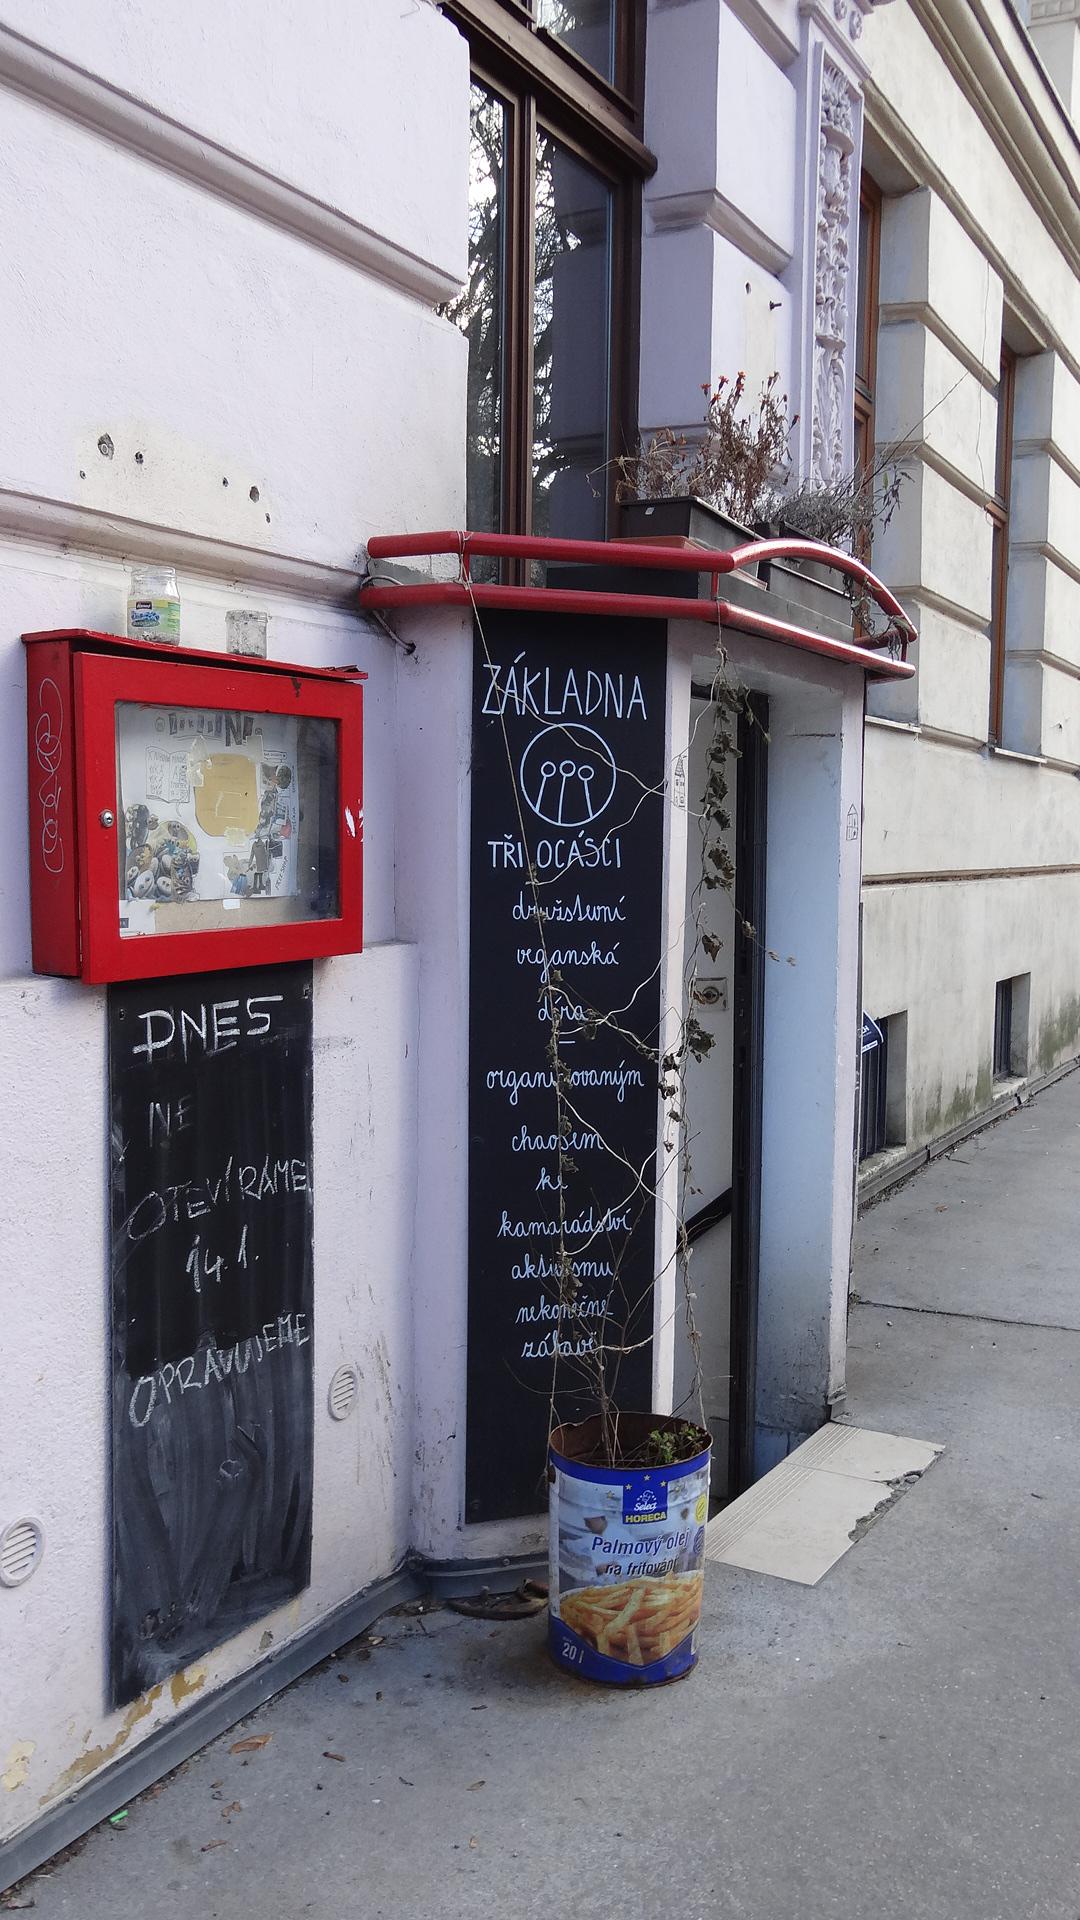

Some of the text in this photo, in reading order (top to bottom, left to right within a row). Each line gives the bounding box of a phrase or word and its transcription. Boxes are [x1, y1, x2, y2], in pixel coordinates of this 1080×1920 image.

[482, 651, 647, 720] ZÁKLADNA
[487, 834, 523, 868] TŘI
[512, 891, 626, 922] družstevní
[516, 941, 619, 983] veganská
[538, 995, 589, 1021] dra
[132, 994, 284, 1064] DNES
[486, 1060, 645, 1106] organiovaným
[150, 1095, 192, 1148] NE
[511, 1124, 604, 1152] chaosem
[535, 1166, 569, 1191] ke
[497, 1206, 633, 1239] kamarádství
[511, 1253, 614, 1280] aktivsmu
[625, 1511, 667, 1523] HORECA
[633, 1501, 657, 1512] Select
[591, 1534, 663, 1556] Palmový
[666, 1528, 690, 1550] olej
[605, 1563, 622, 1576] na
[562, 1641, 577, 1661] 20
